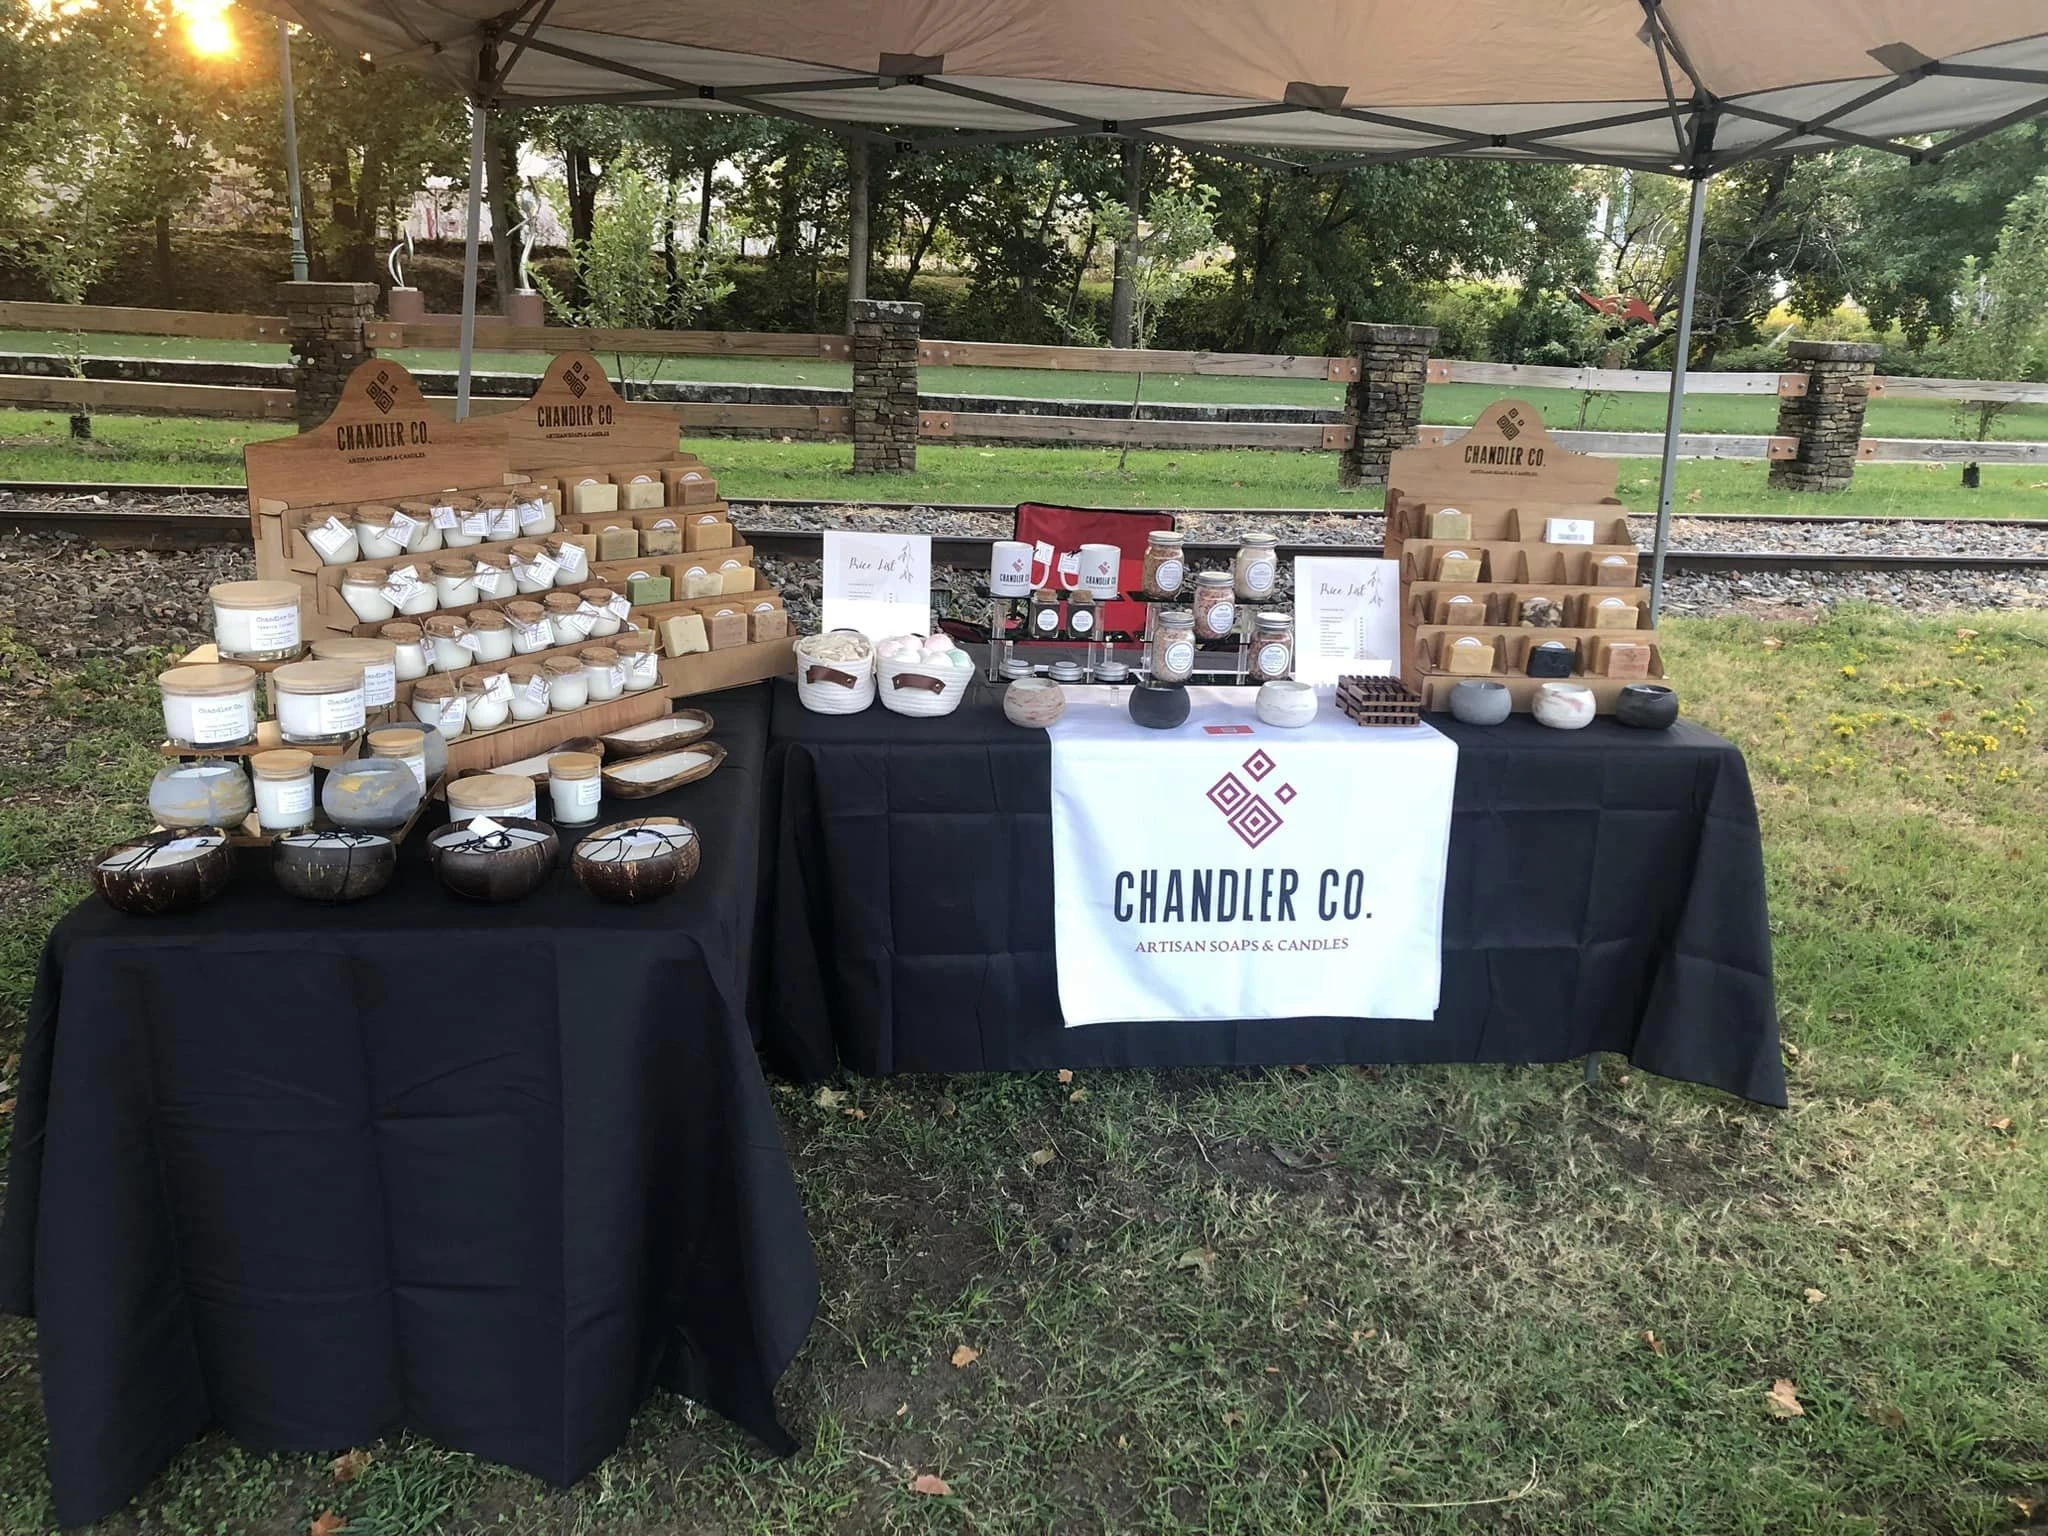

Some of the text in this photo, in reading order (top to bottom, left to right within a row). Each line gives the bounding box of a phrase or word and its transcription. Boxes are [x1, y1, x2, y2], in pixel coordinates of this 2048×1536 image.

[537, 403, 616, 428] CHANDLER CO.
[336, 420, 433, 452] CHANDLER CO.
[1463, 445, 1547, 468] CHANDLER CO.
[848, 556, 897, 573] Price List
[999, 573, 1025, 583] CHANDLER
[1085, 575, 1113, 586] CHANDLER
[1319, 582, 1367, 597] Price List
[1113, 868, 1373, 924] CHANDLER CO.
[1135, 937, 1350, 953] ARTISAN SOAPS & CANDLES
